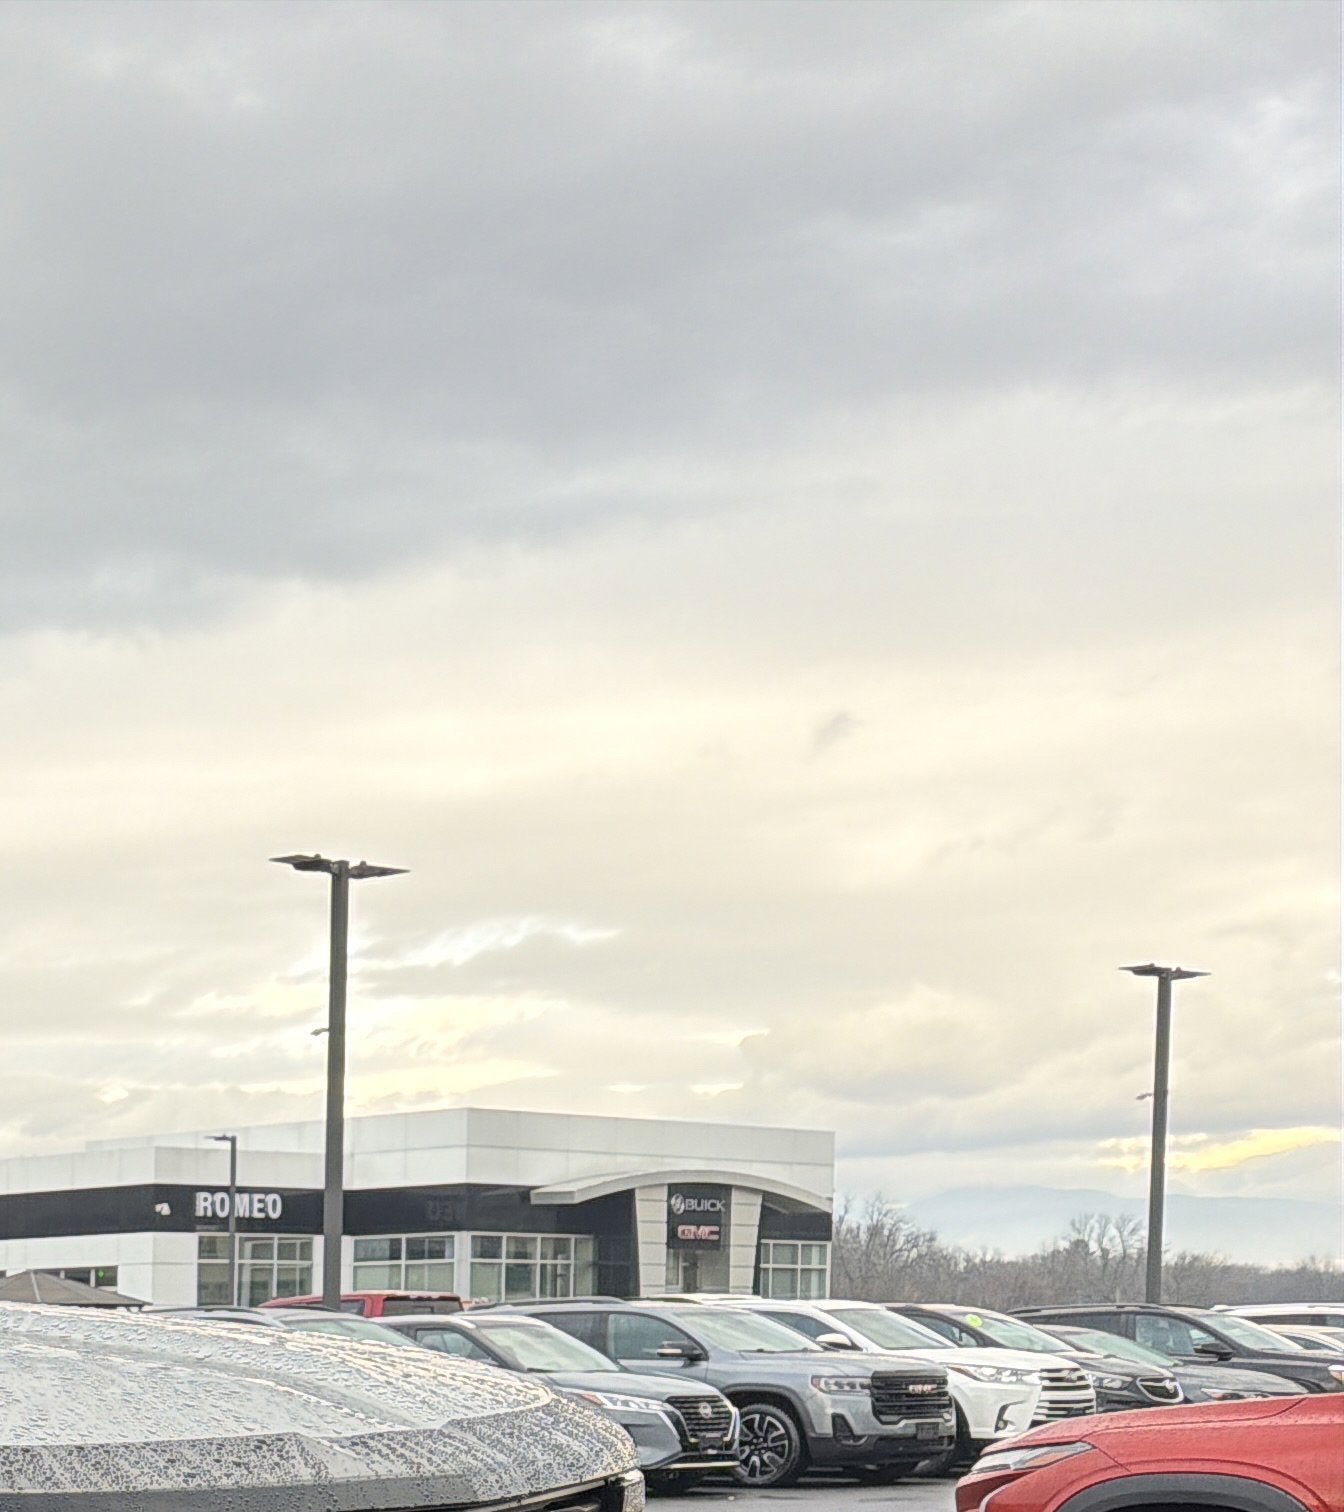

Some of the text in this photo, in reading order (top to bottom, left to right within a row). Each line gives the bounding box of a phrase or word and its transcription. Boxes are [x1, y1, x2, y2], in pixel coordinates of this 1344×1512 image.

[194, 1191, 283, 1219] ROMEO
[685, 1198, 726, 1212] BUICK
[677, 1224, 720, 1240] GMC
